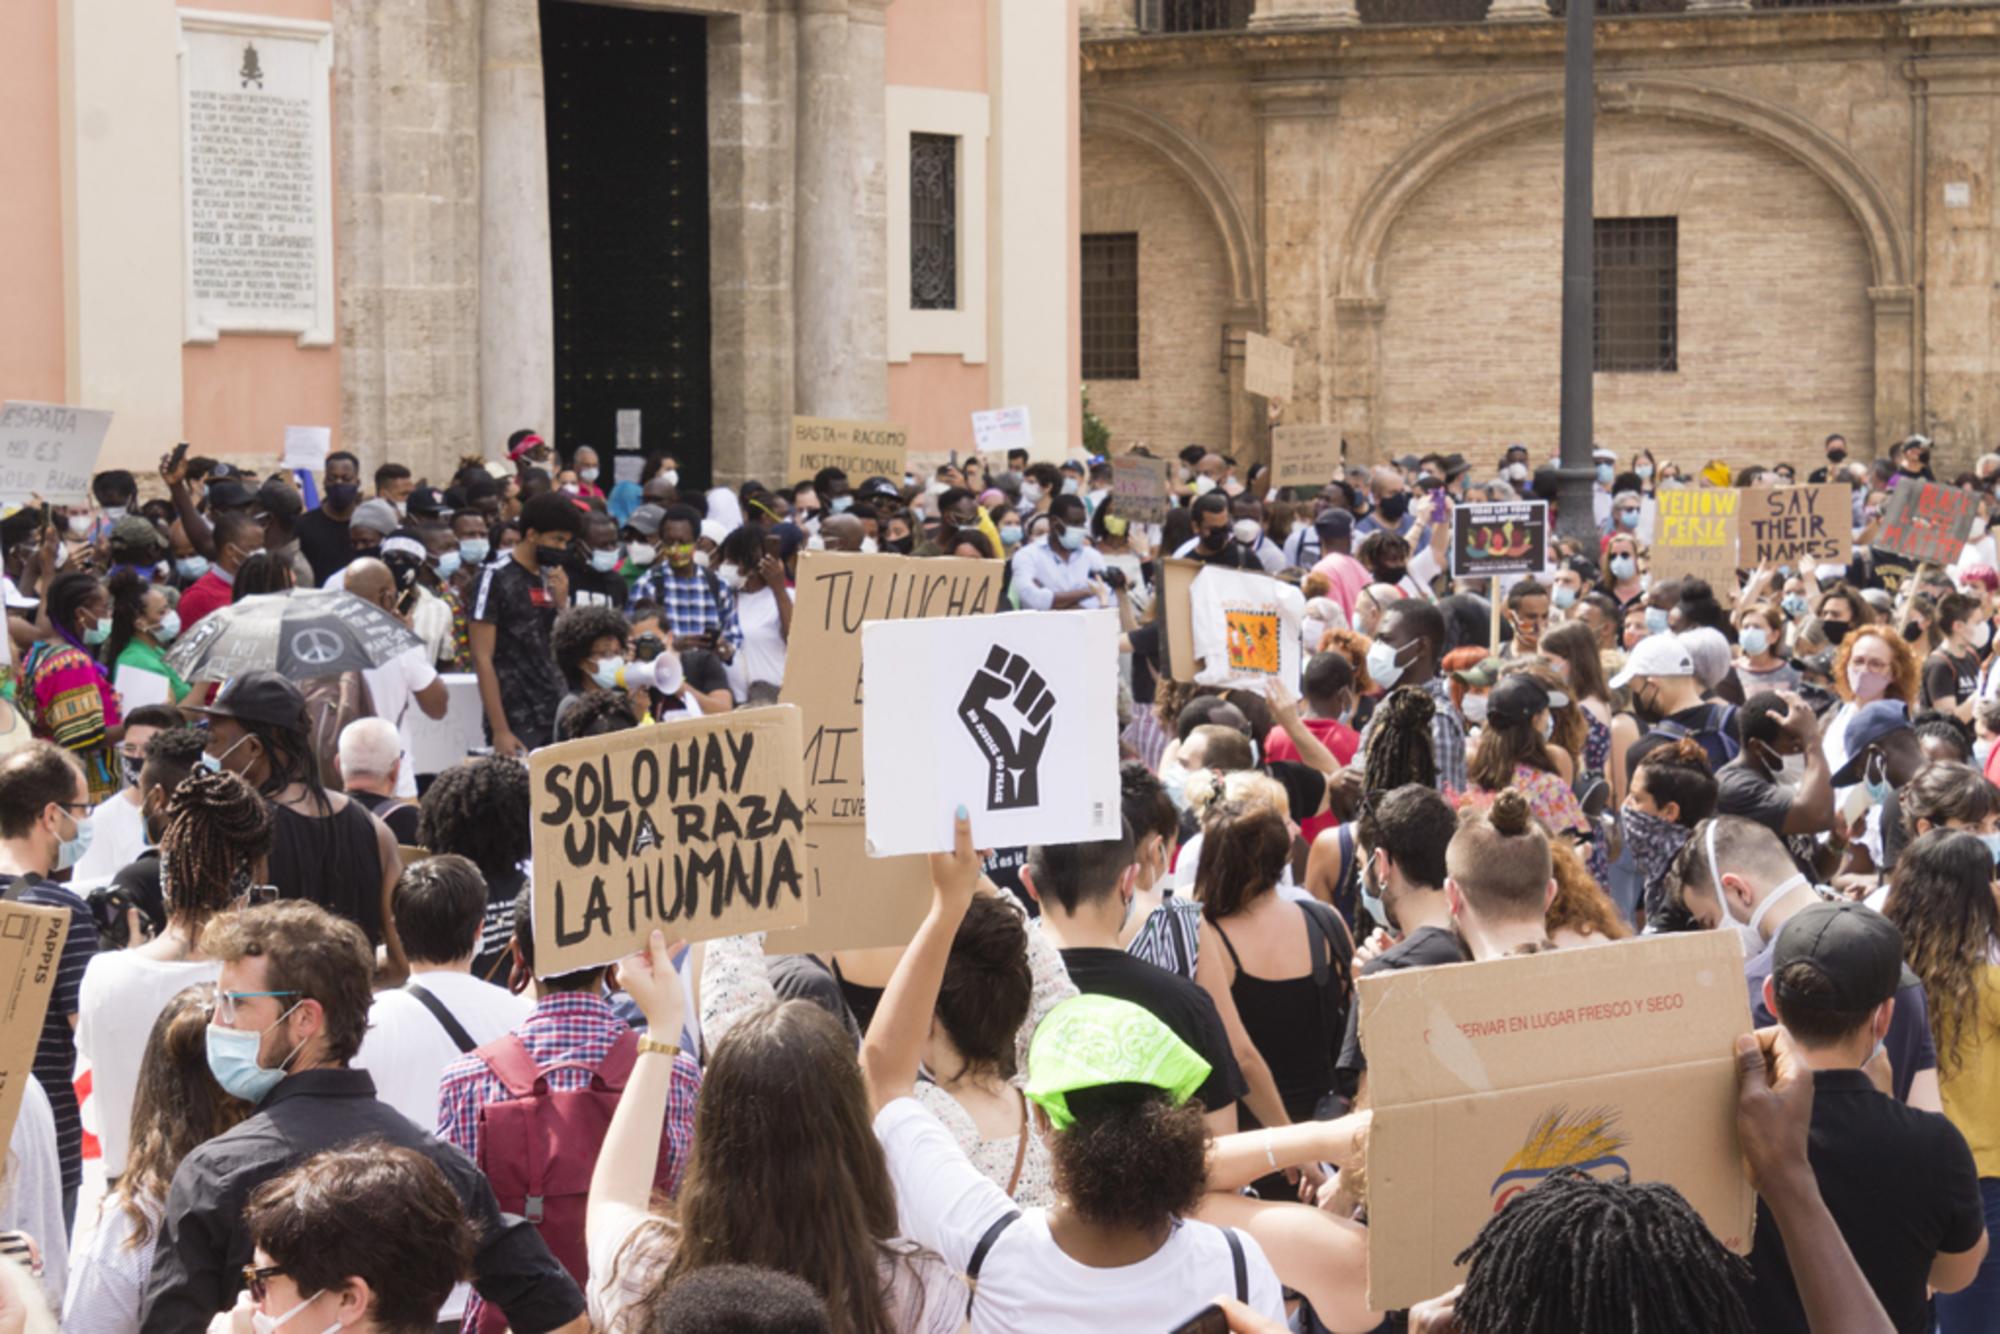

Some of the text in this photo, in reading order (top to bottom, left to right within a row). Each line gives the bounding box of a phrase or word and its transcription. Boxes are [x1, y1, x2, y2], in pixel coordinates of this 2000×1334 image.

[34, 441, 63, 462] ES
[795, 425, 836, 443] BASTA
[852, 428, 907, 447] RACISMO
[800, 453, 900, 476] INSTITUCIONAL
[1751, 517, 1826, 540] THEIR
[1767, 489, 1820, 517] SAY
[1756, 540, 1841, 562] NAMES
[815, 570, 874, 634] TU
[541, 728, 754, 826] SOLO HAY
[966, 708, 1006, 804] NO JUSTICE NO PEACE
[564, 788, 805, 868] UNA RAZA
[554, 874, 612, 948] LA
[627, 838, 803, 935] HUMNA
[34, 917, 64, 985] PAPPIS
[1423, 992, 1685, 1045] CERVAR EN LUGAR FRESCO Y SECO
